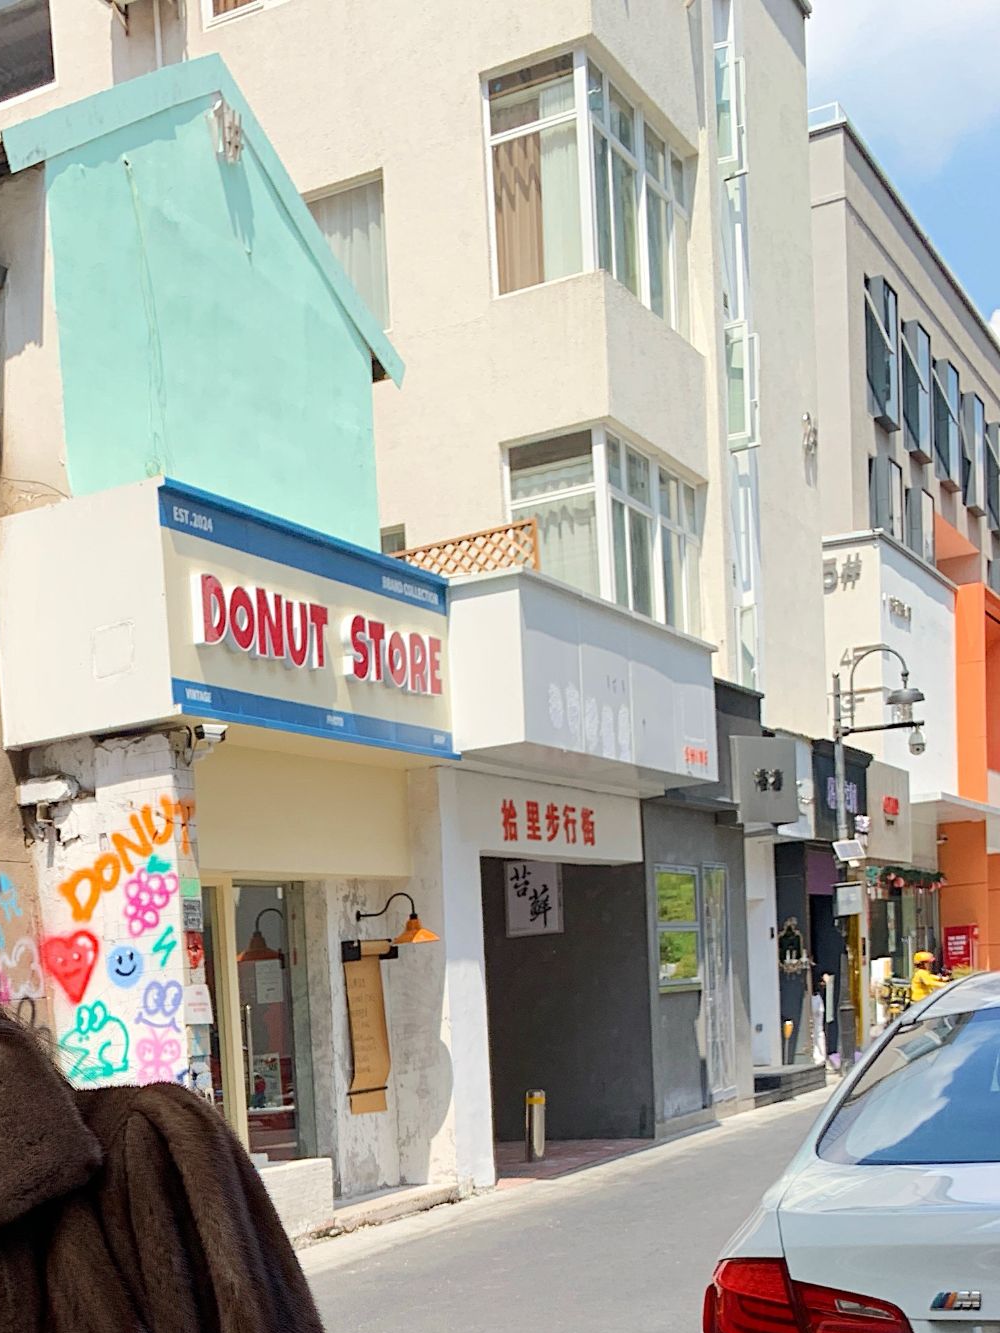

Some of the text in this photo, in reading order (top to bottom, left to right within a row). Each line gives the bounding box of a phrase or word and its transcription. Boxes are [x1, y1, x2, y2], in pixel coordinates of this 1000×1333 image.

[172, 505, 213, 533] EST.2024
[198, 572, 443, 696] DONUT STORE
[58, 794, 197, 923] DONUT
